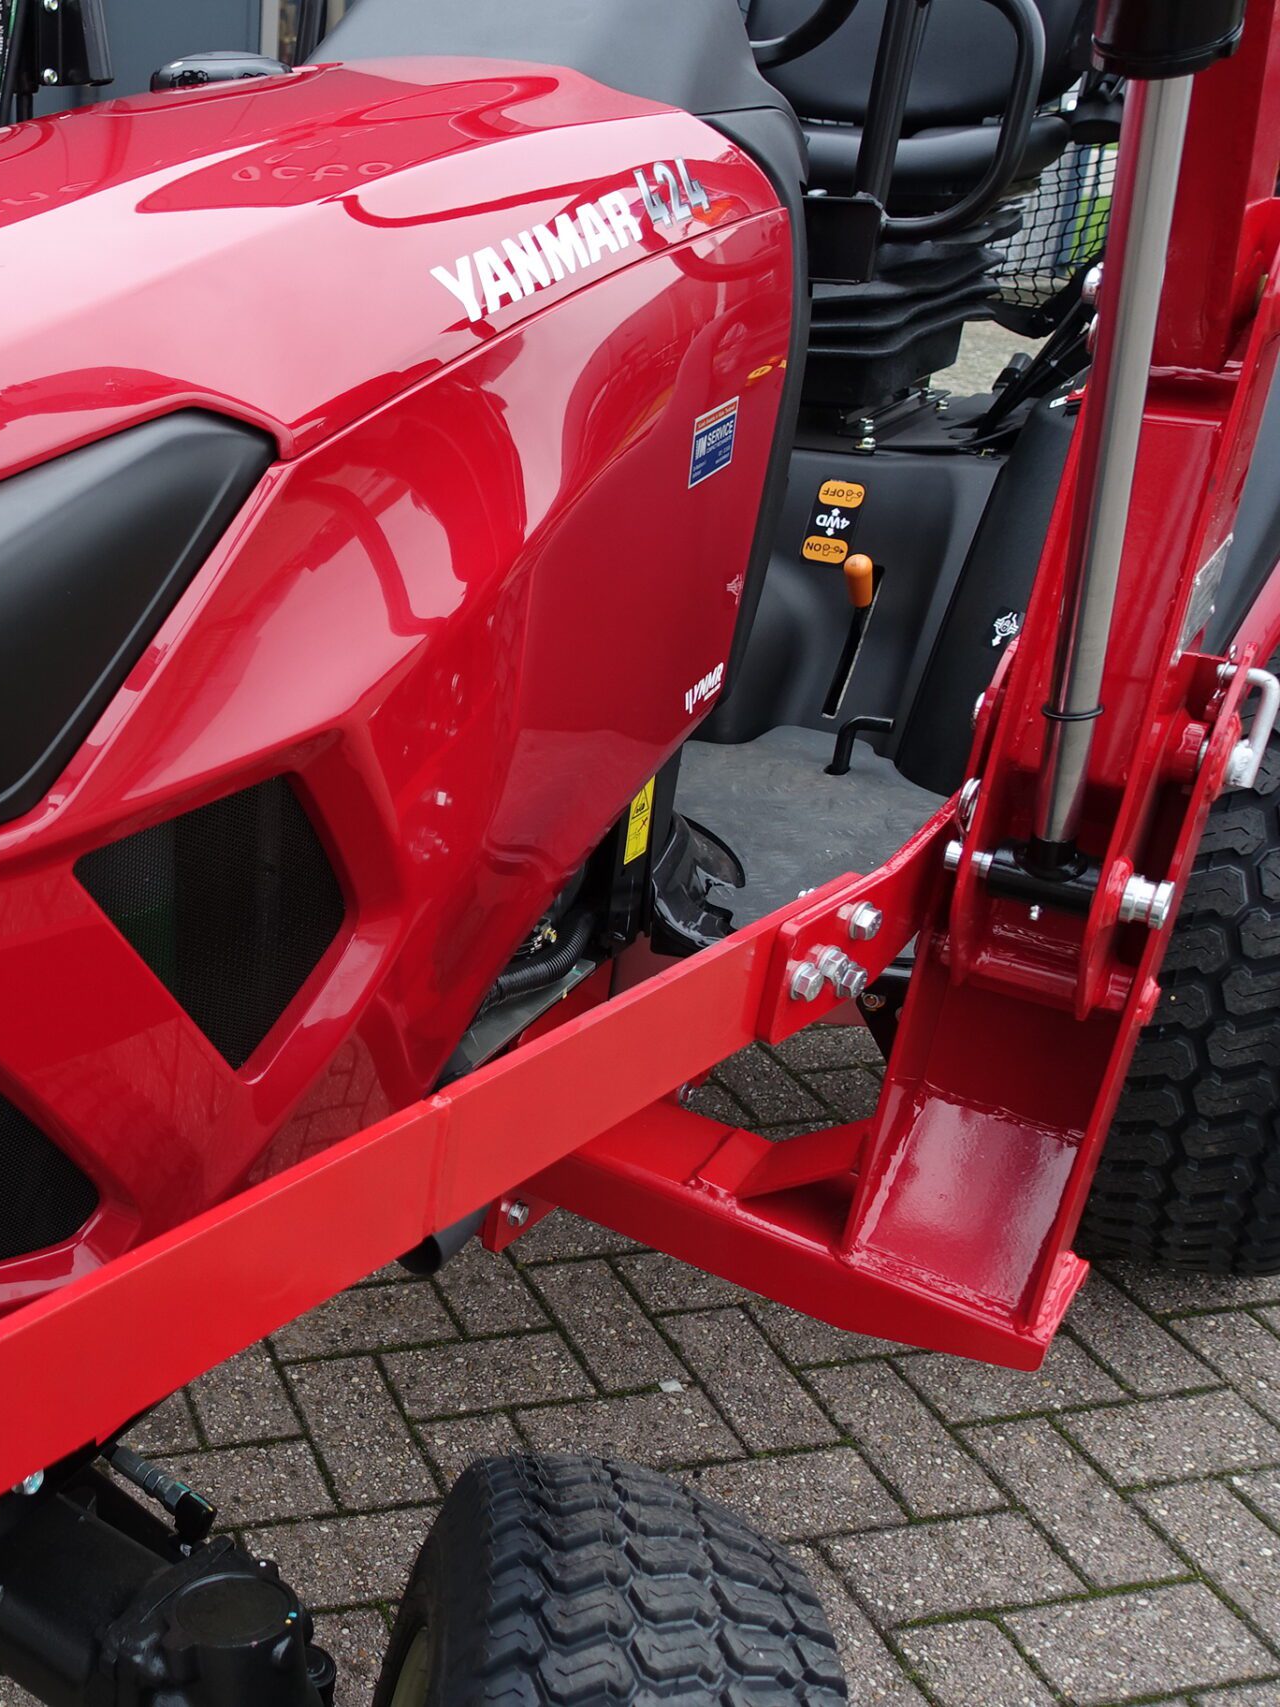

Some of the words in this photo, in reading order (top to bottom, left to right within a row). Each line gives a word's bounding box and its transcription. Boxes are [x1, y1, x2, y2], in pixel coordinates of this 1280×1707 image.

[429, 190, 643, 324] YANMAR
[632, 155, 712, 229] 424
[706, 420, 734, 446] SERVICE
[822, 487, 845, 498] OFF
[815, 514, 851, 530] 4WD
[805, 542, 822, 552] ON
